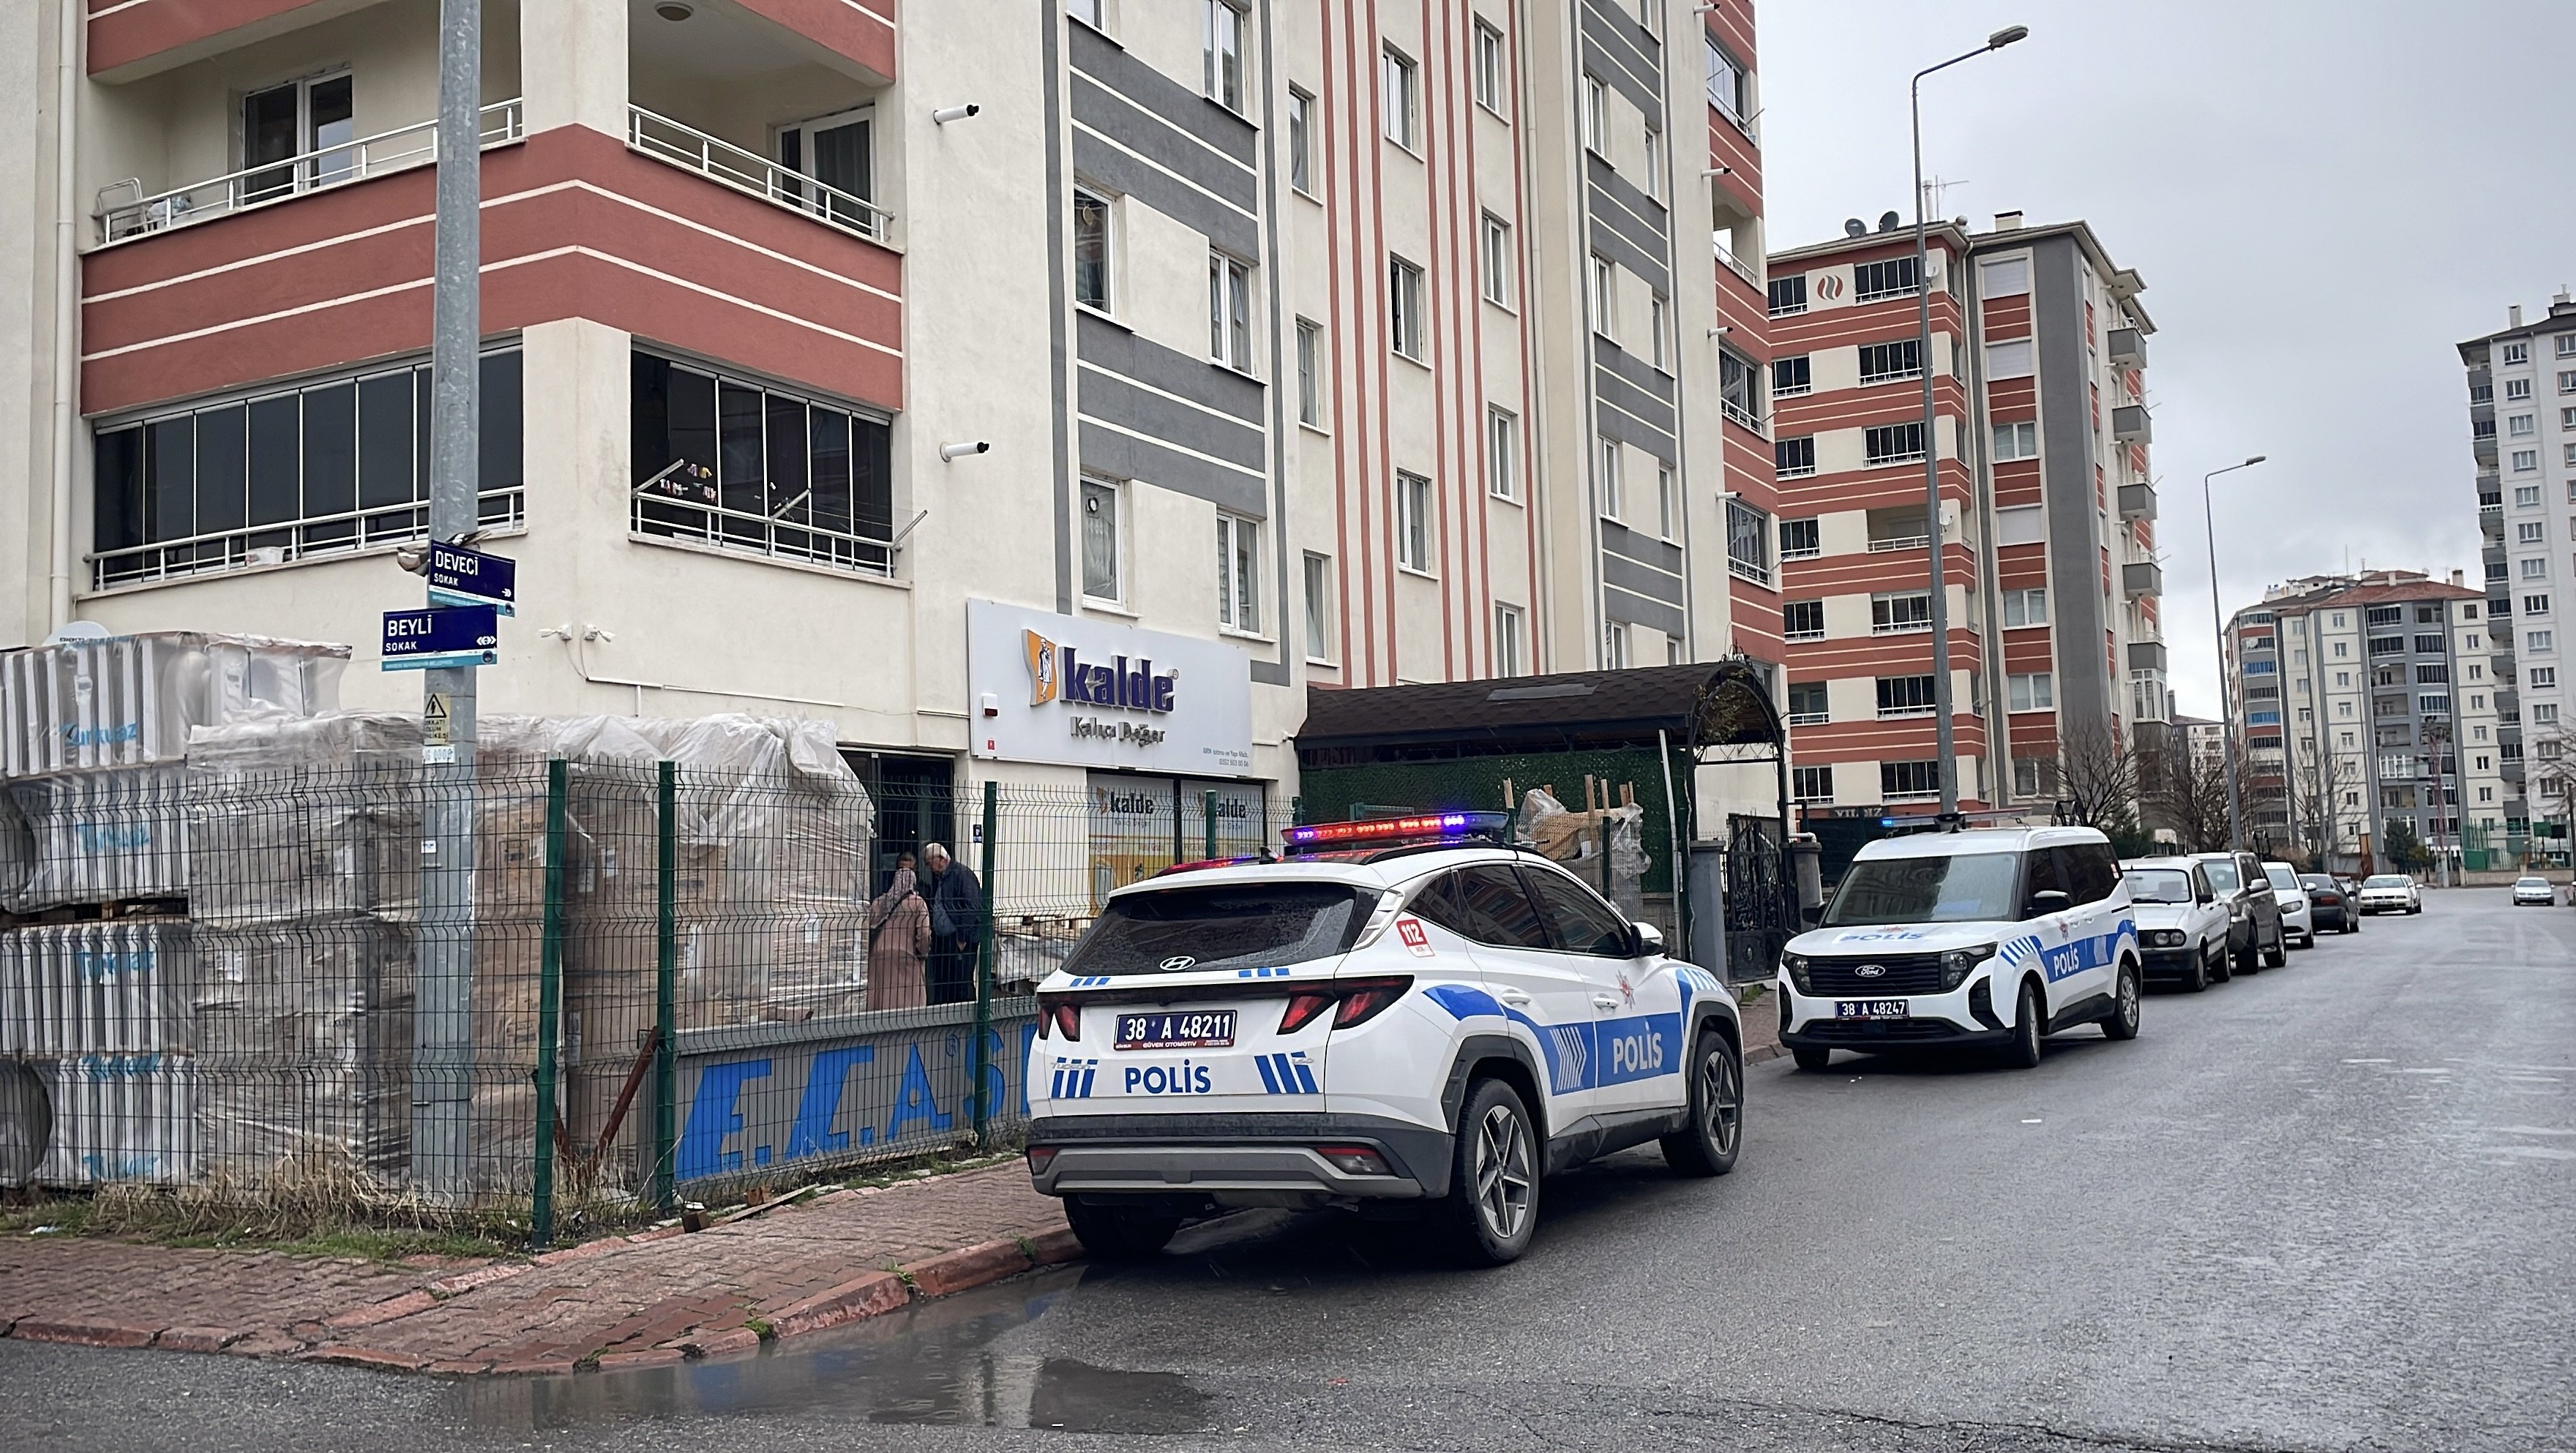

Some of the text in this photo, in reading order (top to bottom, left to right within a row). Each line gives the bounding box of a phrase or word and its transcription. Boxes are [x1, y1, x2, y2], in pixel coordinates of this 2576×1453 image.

[435, 550, 479, 576] DEVECİ
[434, 572, 459, 586] SOKAK
[387, 615, 433, 637] BEYLİ
[385, 641, 417, 653] SOKAK
[1058, 646, 1175, 713] kalde
[1110, 791, 1154, 814] kalde
[1215, 798, 1246, 819] alde
[1401, 923, 1424, 944] 112
[1839, 933, 1926, 942] POLİS
[1860, 966, 1880, 976] Ford
[2053, 943, 2079, 977] POLİS
[1842, 1002, 1906, 1015] 38 A 48247
[1125, 1015, 1230, 1041] 38 A 48211
[1612, 1021, 1663, 1075] POLİS
[1125, 1059, 1211, 1094] POLİS
